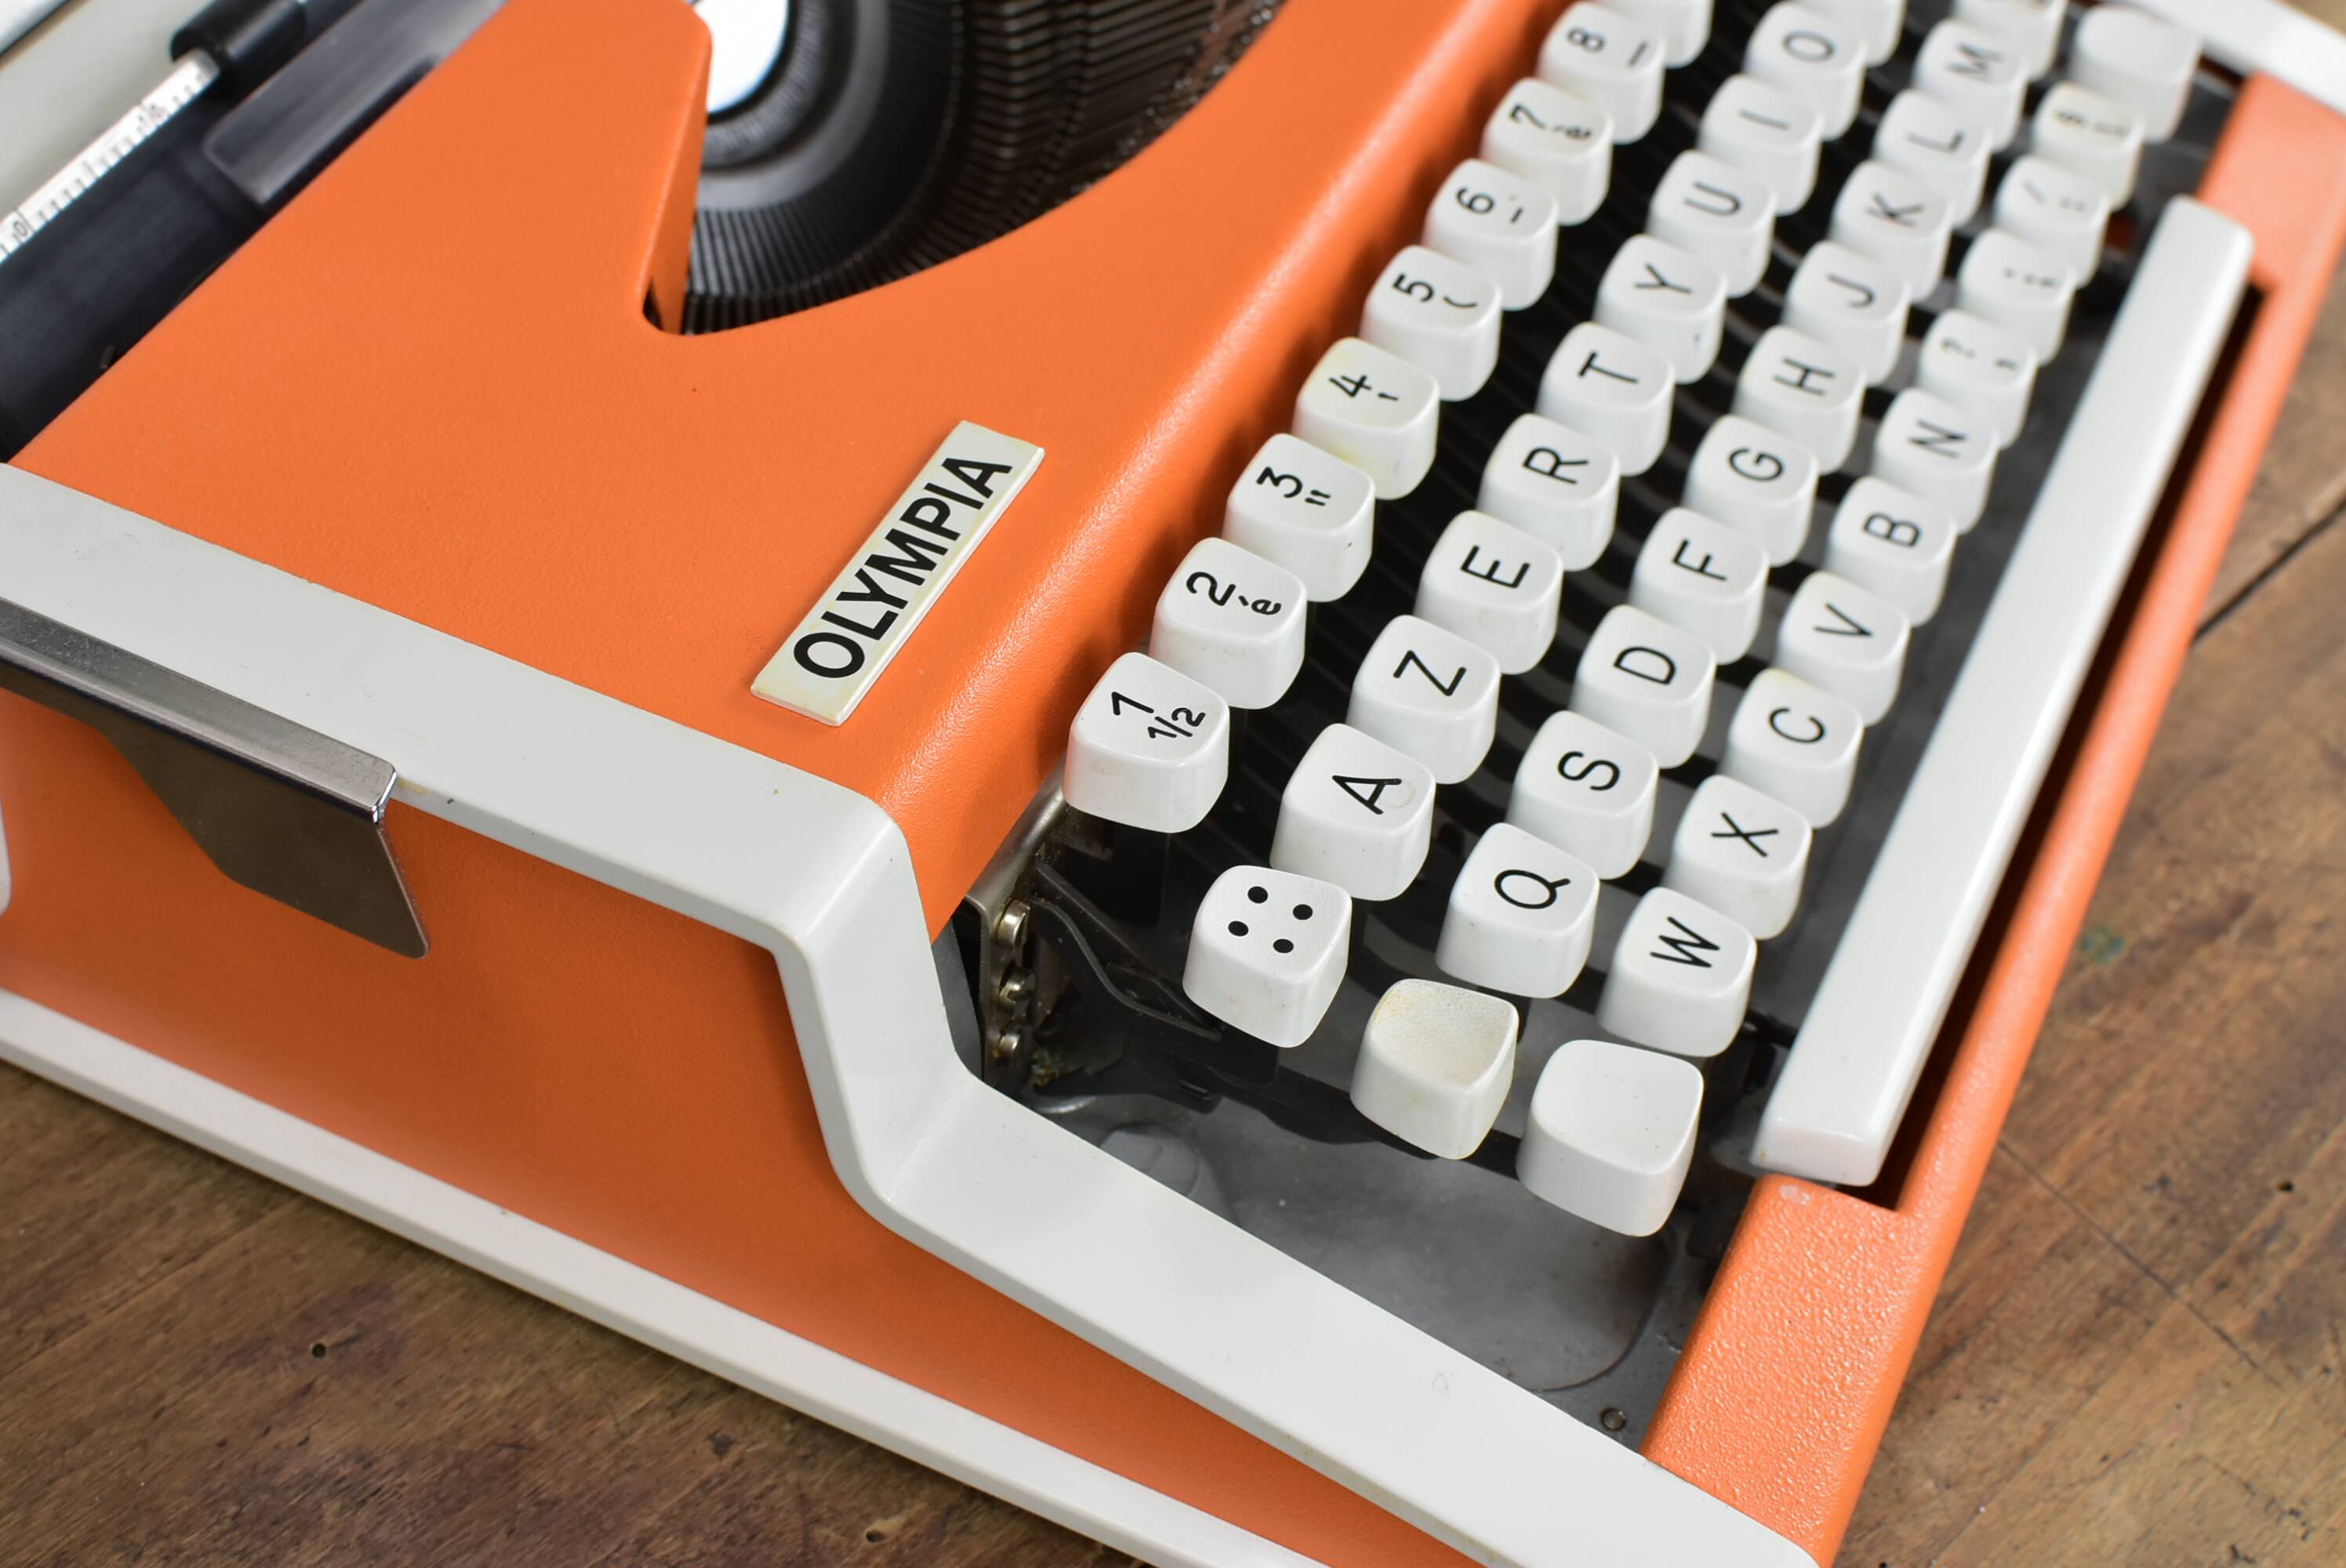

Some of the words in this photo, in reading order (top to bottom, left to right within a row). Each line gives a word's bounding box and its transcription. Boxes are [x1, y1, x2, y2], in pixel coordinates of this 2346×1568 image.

[1567, 28, 1605, 52] 8
[1781, 30, 1837, 63] O
[1948, 42, 2005, 80] M
[1509, 103, 1545, 129] 7
[1739, 110, 1792, 132] I
[1908, 131, 1965, 154] L
[1456, 187, 1495, 214] 6
[1683, 181, 1743, 217] U
[1865, 194, 1926, 228] K
[1393, 274, 1435, 303] 5
[1635, 264, 1692, 295] Y
[1828, 275, 1876, 308] J
[1578, 351, 1637, 383] T
[1773, 356, 1836, 397] H
[1329, 375, 1372, 398] 4
[1908, 419, 1966, 458] N
[1255, 466, 1303, 499] 3
[1522, 447, 1589, 485] R
[1728, 448, 1785, 482] G
[1862, 513, 1922, 548] B
[794, 458, 1012, 678] OLYMPIA
[1460, 545, 1531, 589] E
[1672, 539, 1727, 581] F
[1186, 571, 1237, 607] 2
[1814, 604, 1872, 637] V
[1393, 650, 1467, 697] Z
[1613, 646, 1676, 686] D
[1111, 691, 1155, 716] 1
[1768, 707, 1826, 744] C
[1557, 751, 1621, 792] S
[1331, 775, 1403, 815] A
[1711, 812, 1779, 858] X
[1494, 869, 1571, 910] Q
[1650, 916, 1720, 968] W
